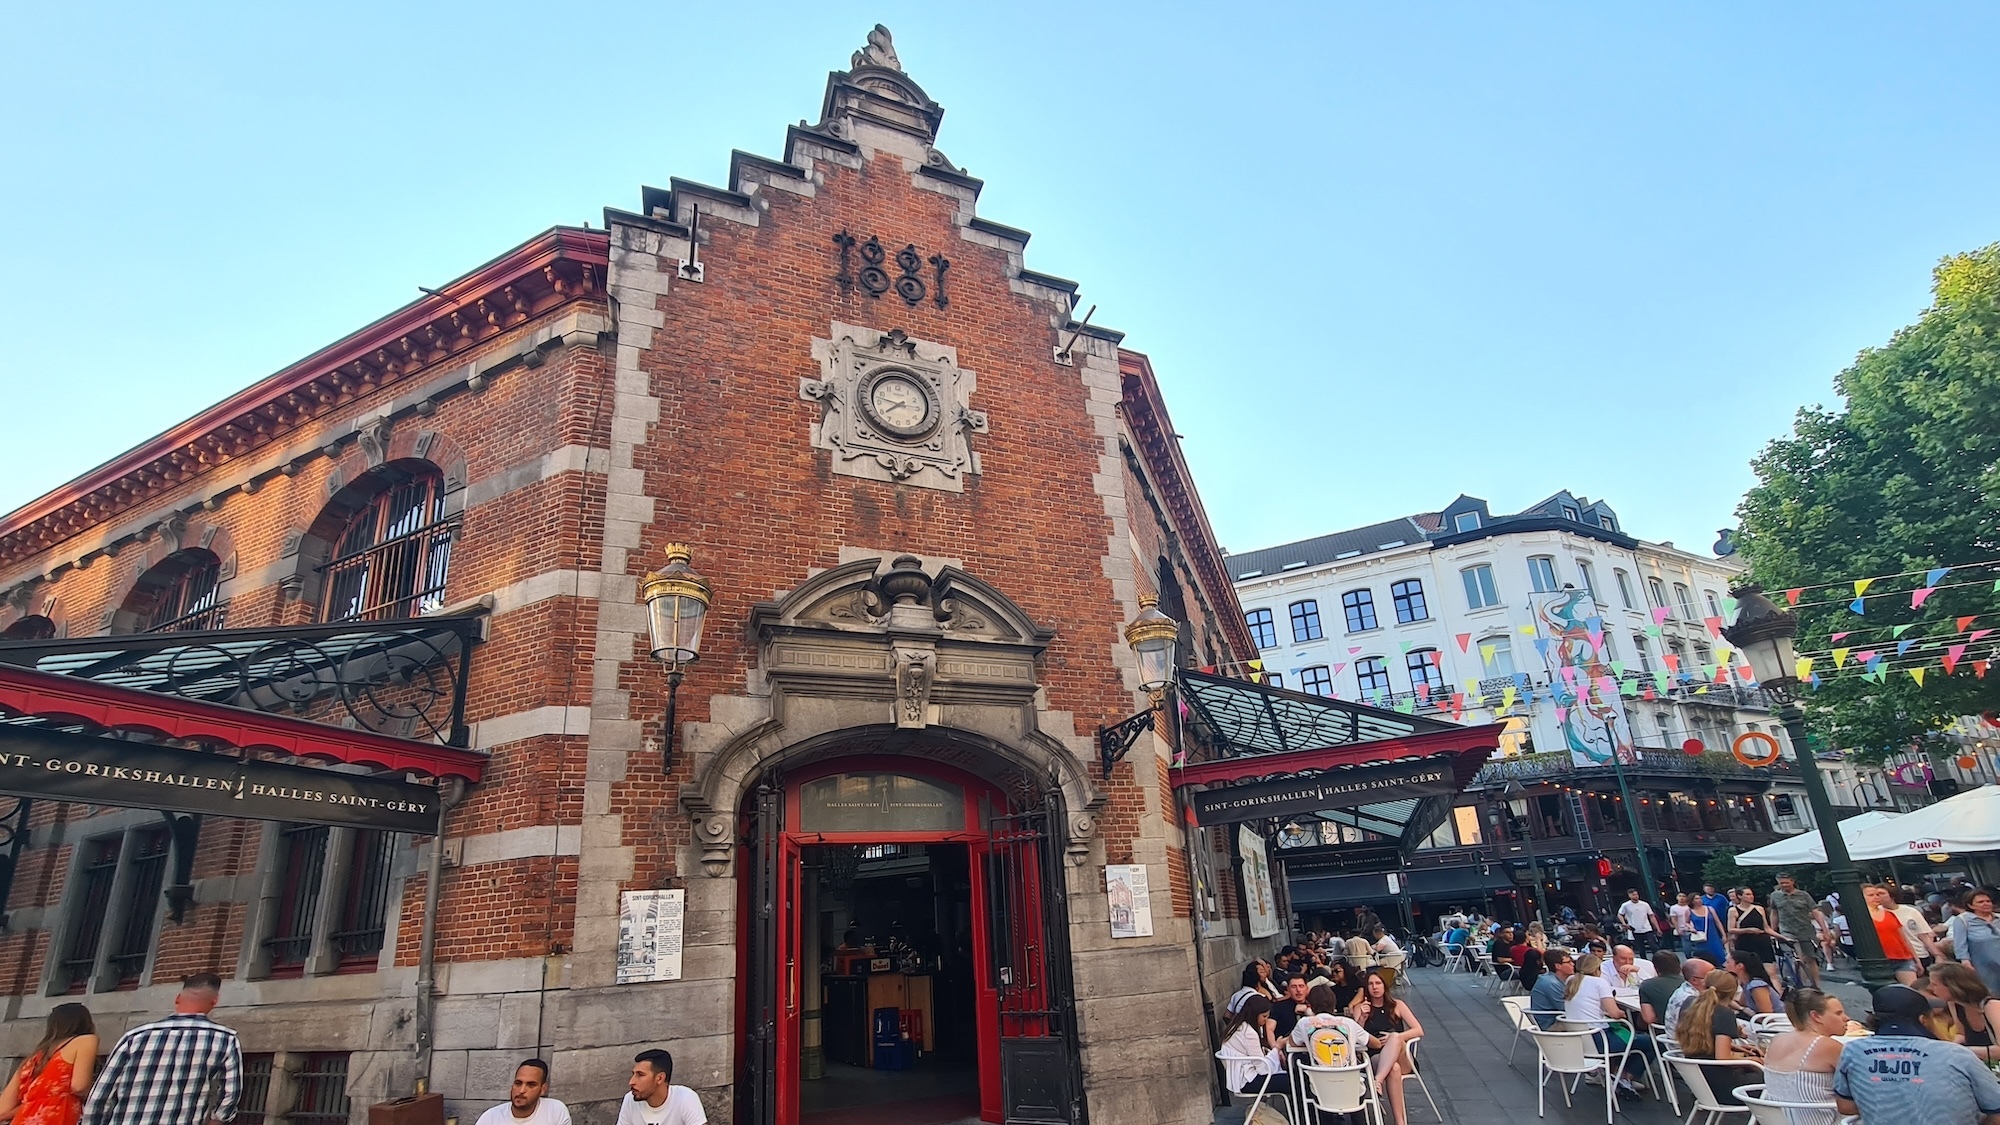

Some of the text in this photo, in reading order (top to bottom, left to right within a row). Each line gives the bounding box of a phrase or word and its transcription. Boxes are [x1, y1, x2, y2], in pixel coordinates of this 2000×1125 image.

[832, 227, 950, 311] 1881
[251, 784, 323, 802] HALLES
[329, 793, 427, 814] SAINT-GÉRY
[1204, 772, 1442, 812] SINT-GORIKSHALLEN HALLES SAINT-GÉRY
[1909, 839, 1942, 849] Duvel
